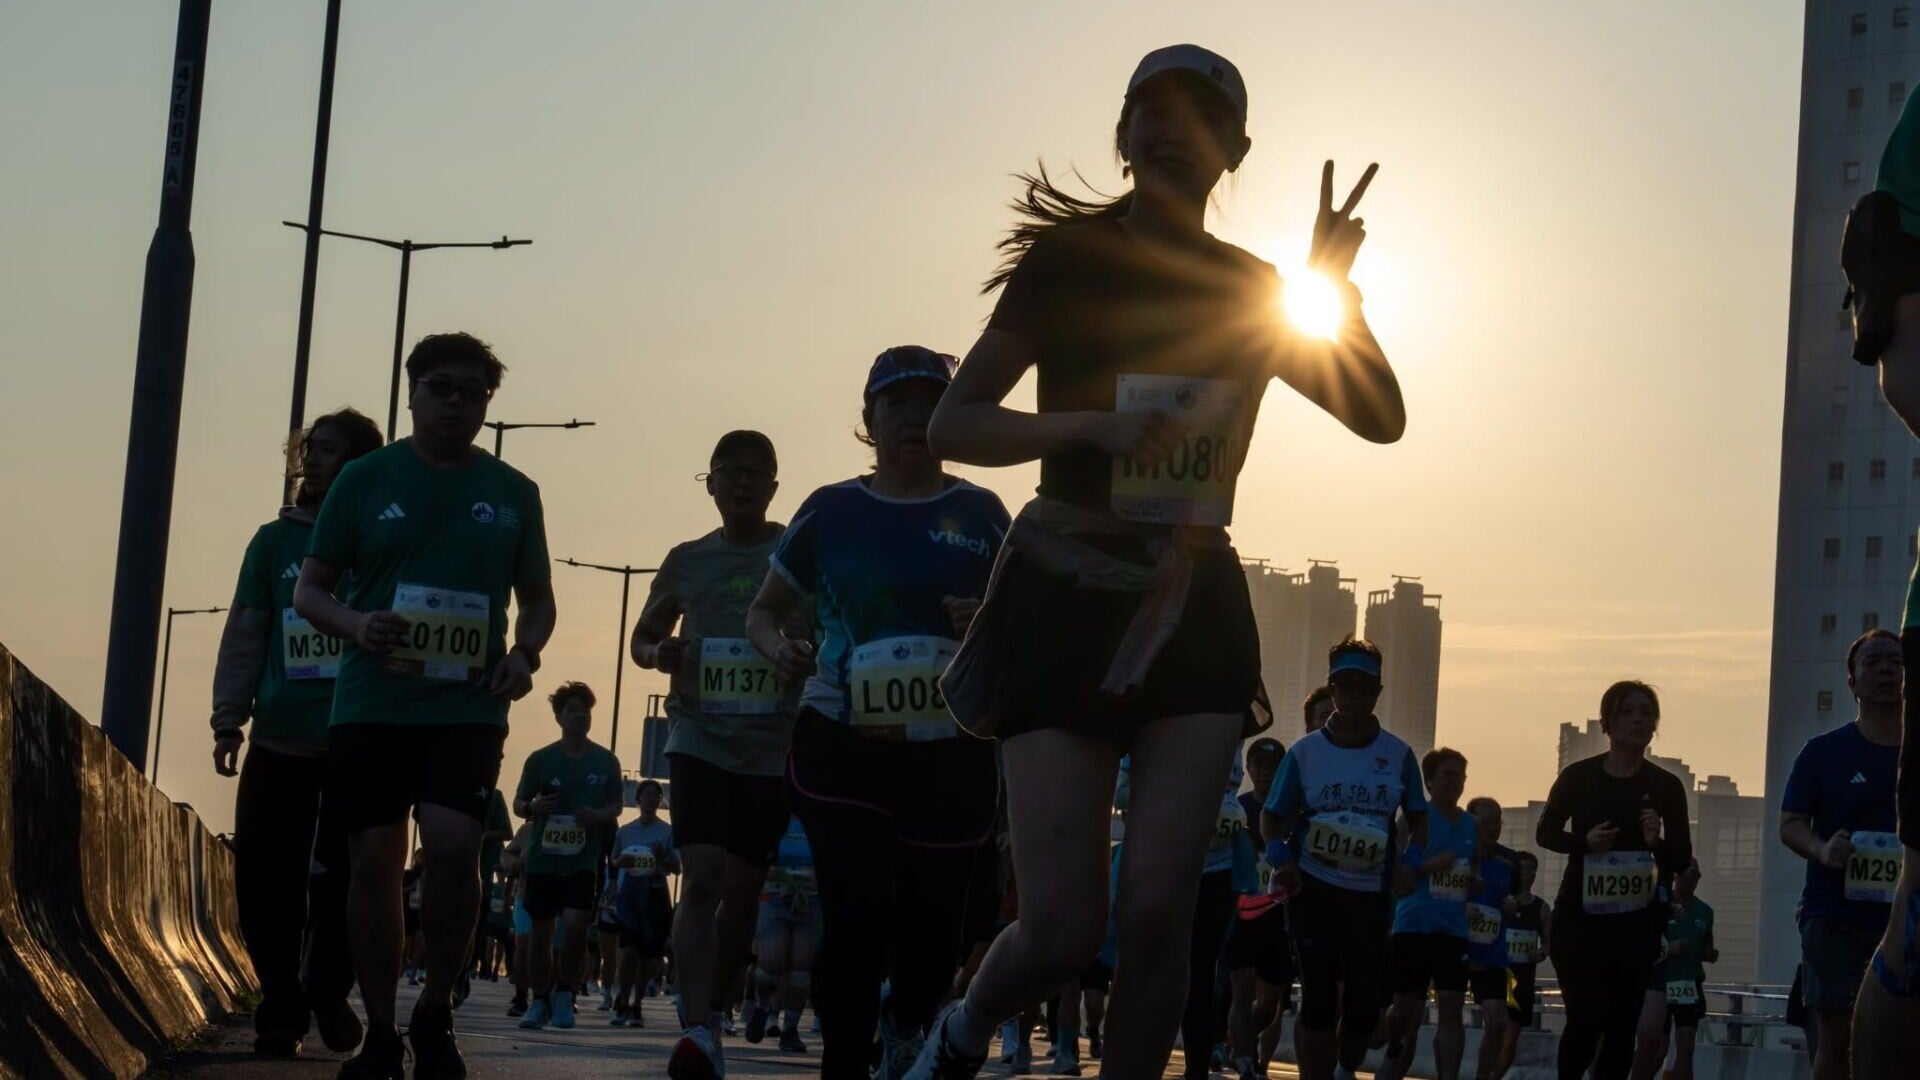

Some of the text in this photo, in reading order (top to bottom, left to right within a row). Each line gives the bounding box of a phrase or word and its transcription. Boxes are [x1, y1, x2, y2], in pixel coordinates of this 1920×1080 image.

[928, 529, 990, 558] vtech
[402, 622, 480, 656] 0100
[704, 667, 779, 692] M1371
[544, 830, 585, 844] M2495
[1313, 830, 1378, 861] L0181
[1851, 858, 1902, 882] M29
[1588, 875, 1653, 896] M2991
